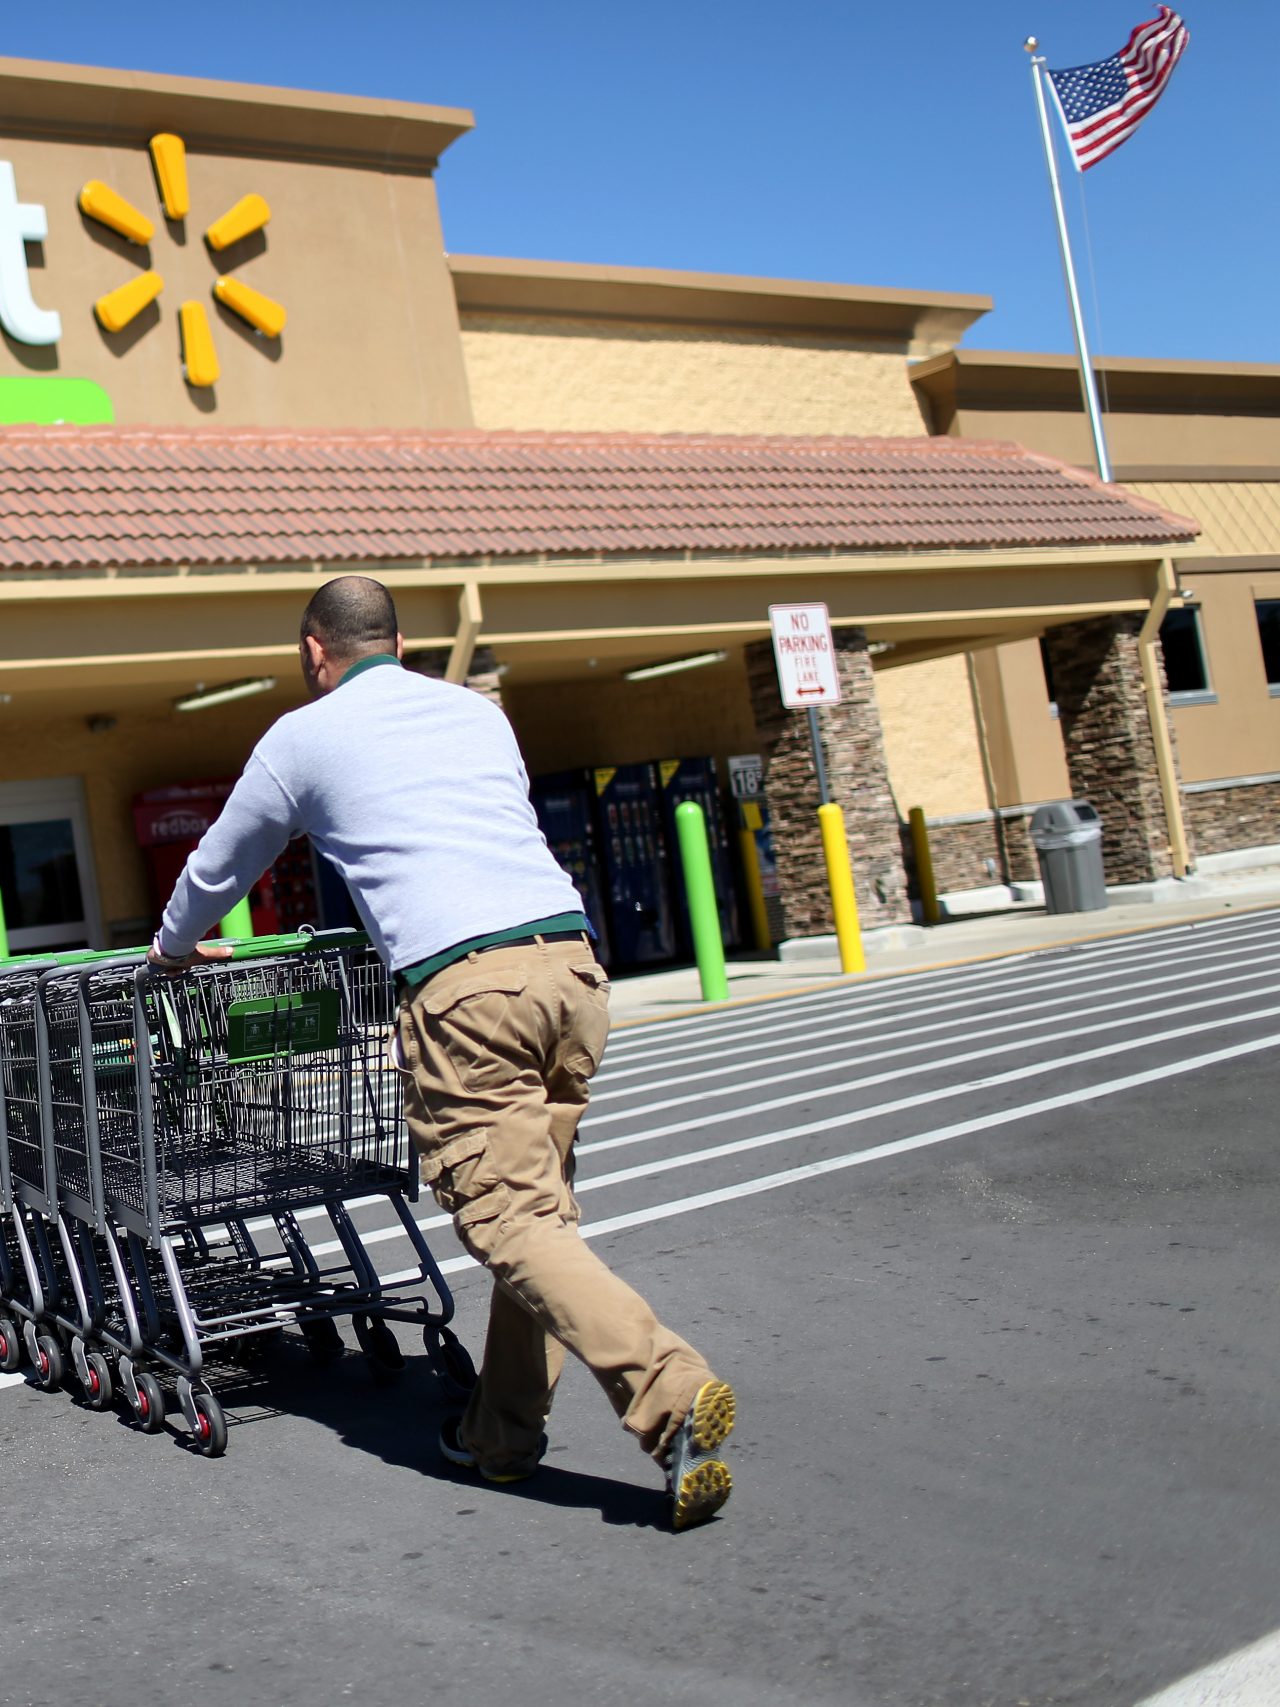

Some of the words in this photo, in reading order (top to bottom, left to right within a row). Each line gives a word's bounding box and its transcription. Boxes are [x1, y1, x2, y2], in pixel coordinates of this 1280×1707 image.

[790, 613, 809, 631] NO
[779, 634, 828, 654] PARKING
[150, 815, 209, 837] redbox
